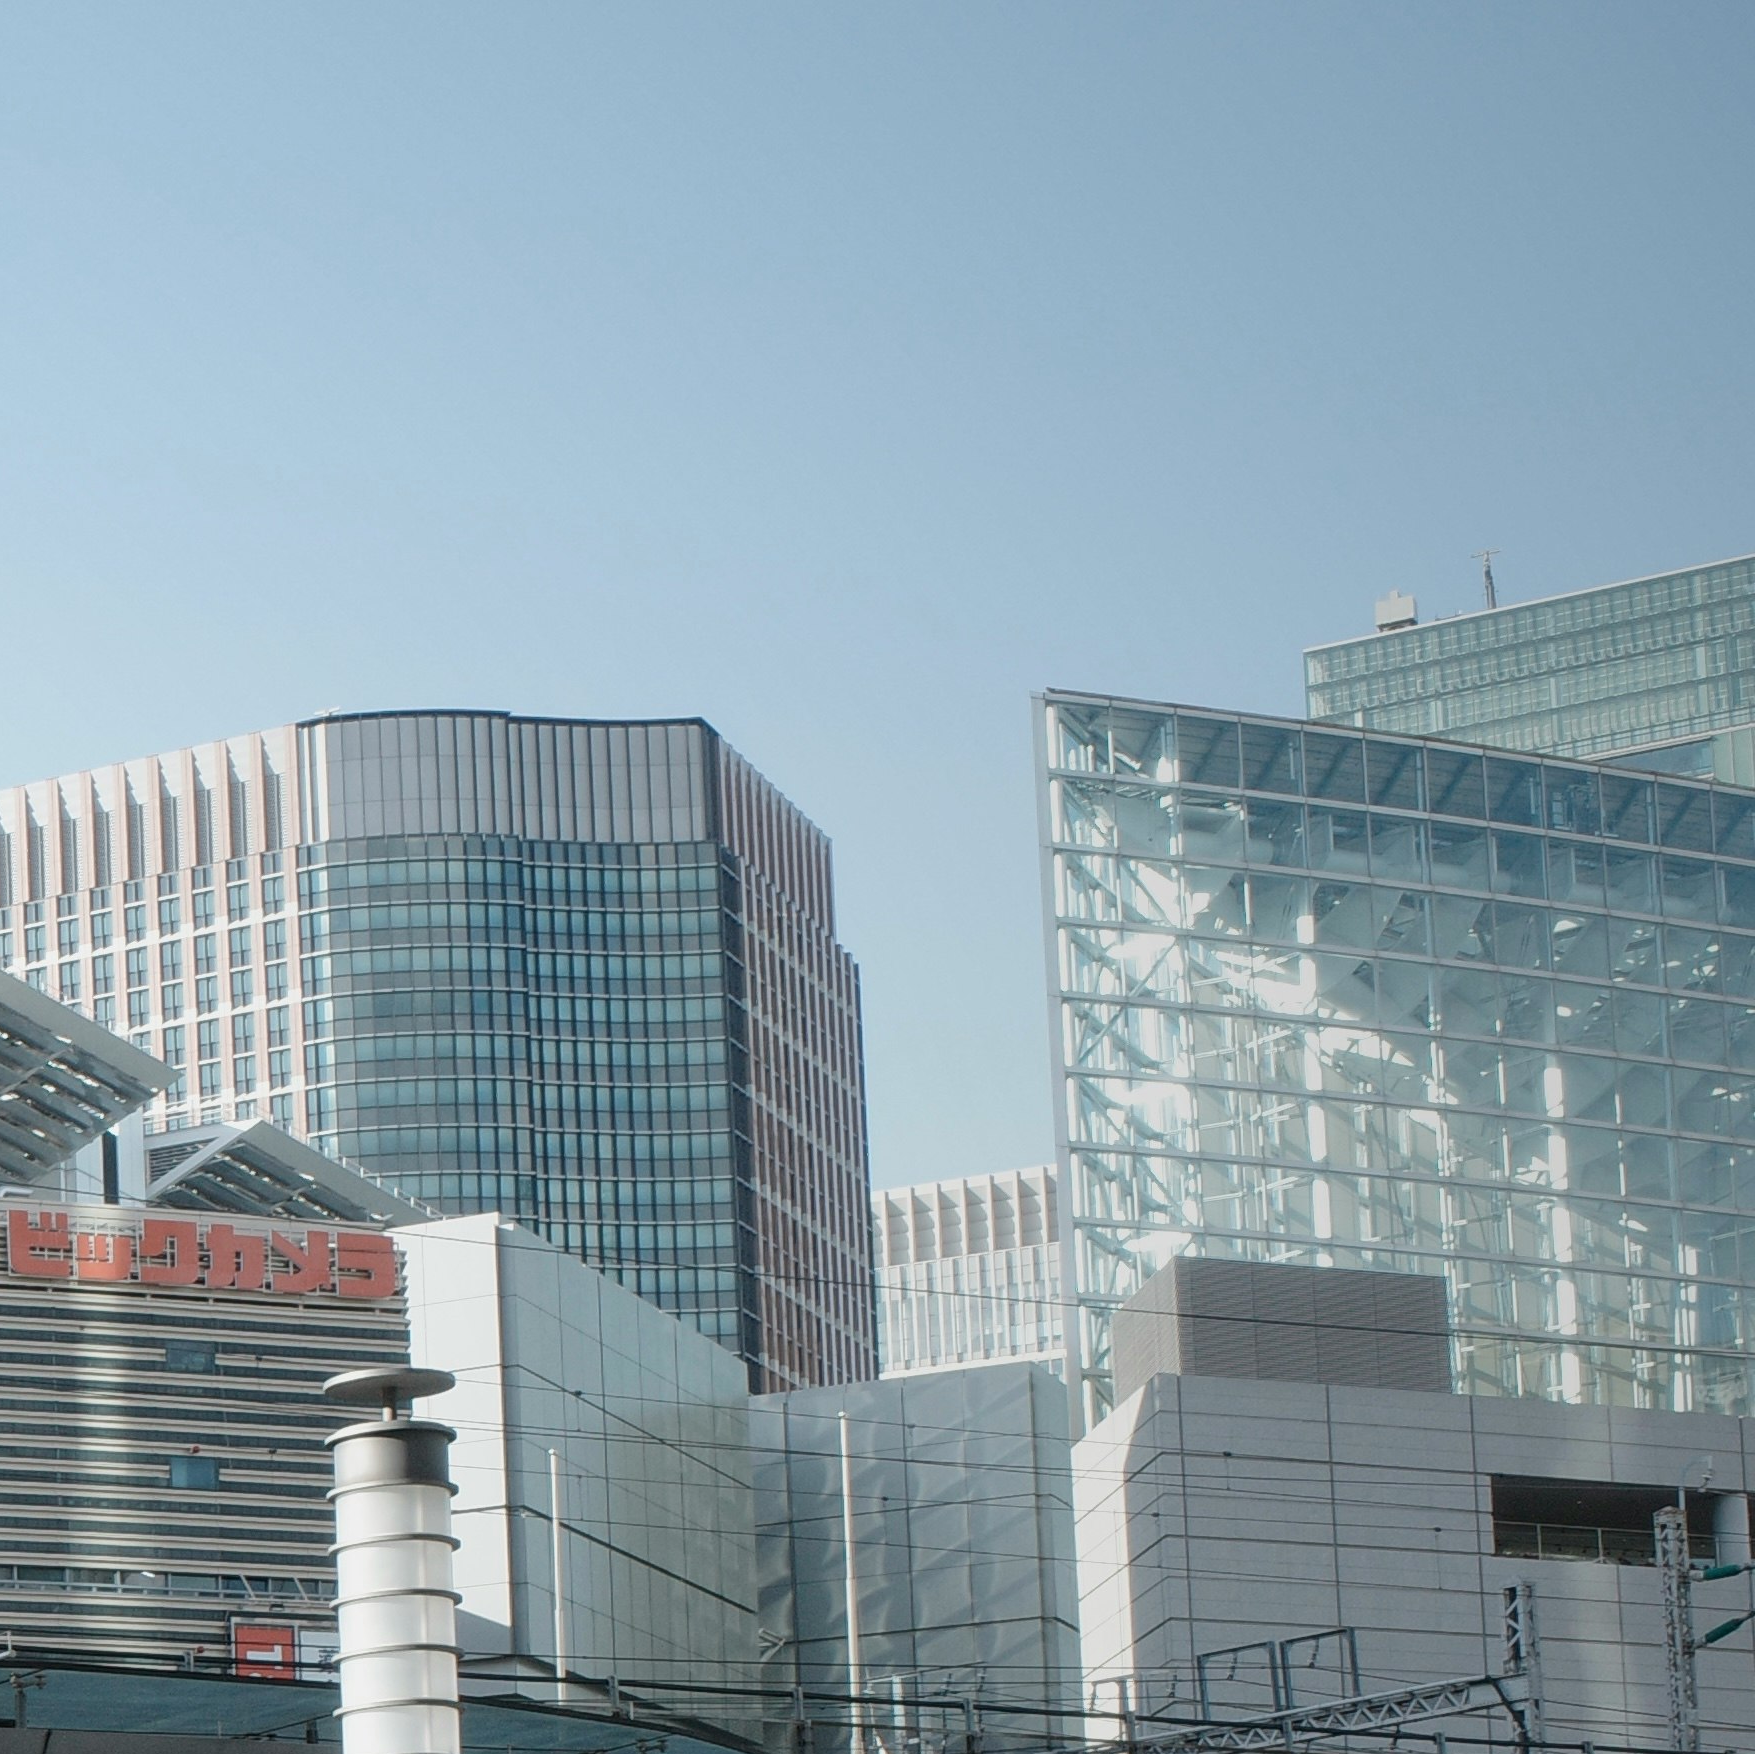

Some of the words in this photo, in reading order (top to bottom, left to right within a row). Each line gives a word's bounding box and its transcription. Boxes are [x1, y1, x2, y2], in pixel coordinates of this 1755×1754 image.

[6, 1208, 400, 1299] ビックカメラ
